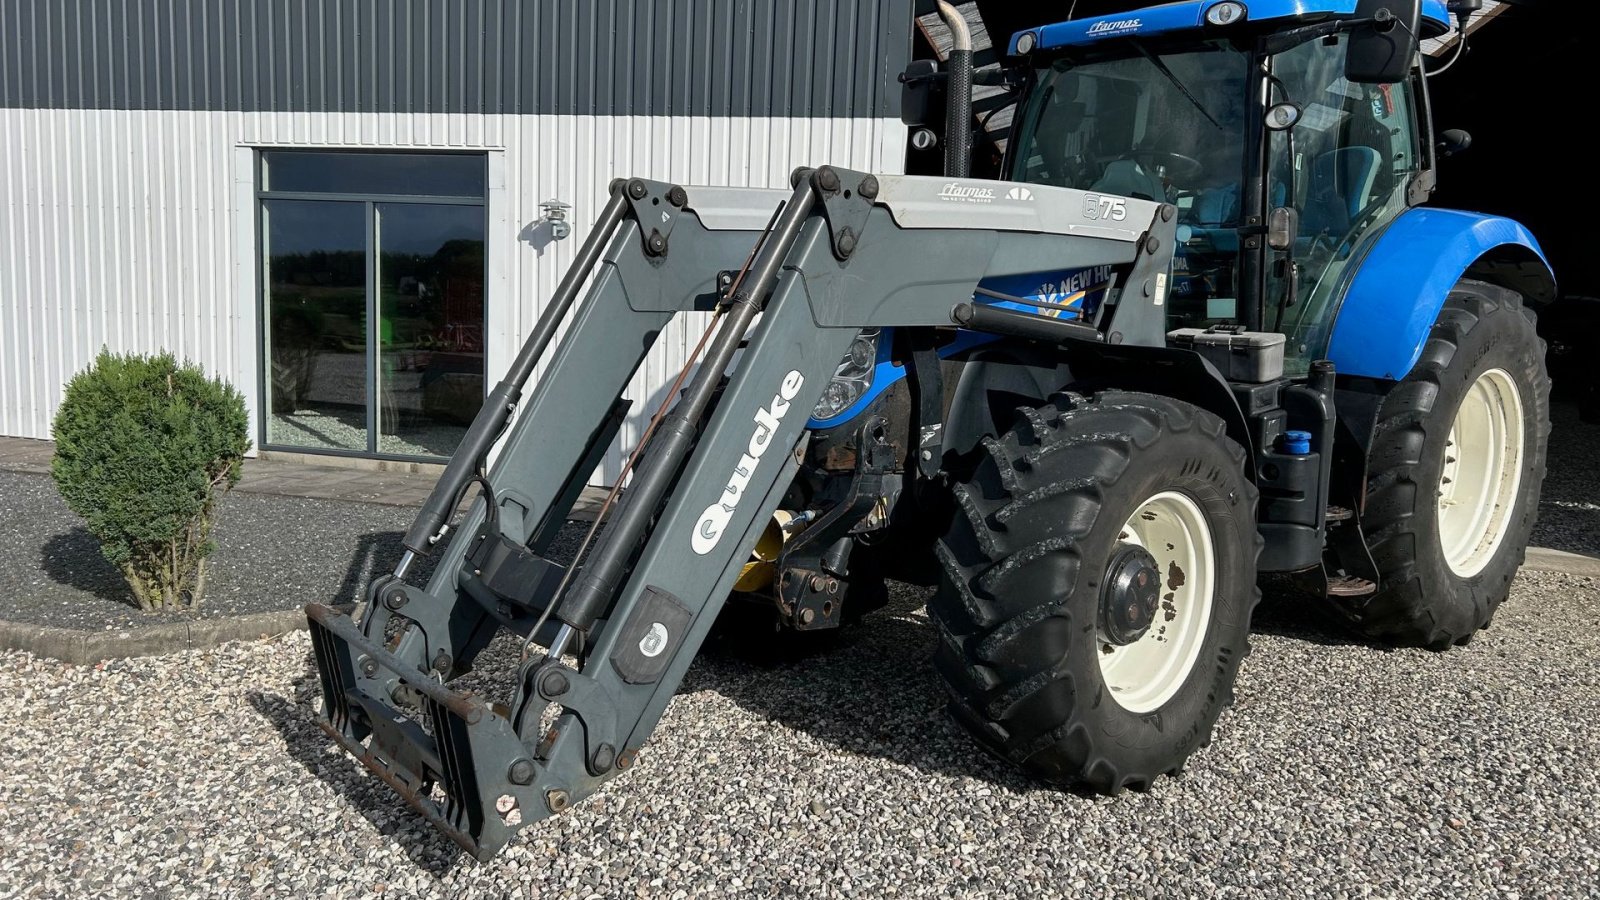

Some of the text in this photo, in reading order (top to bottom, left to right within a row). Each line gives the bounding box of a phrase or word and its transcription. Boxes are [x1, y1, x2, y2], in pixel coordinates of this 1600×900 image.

[1083, 193, 1126, 221] Q75
[1060, 268, 1092, 297] NEW
[691, 369, 805, 555] Quicke
